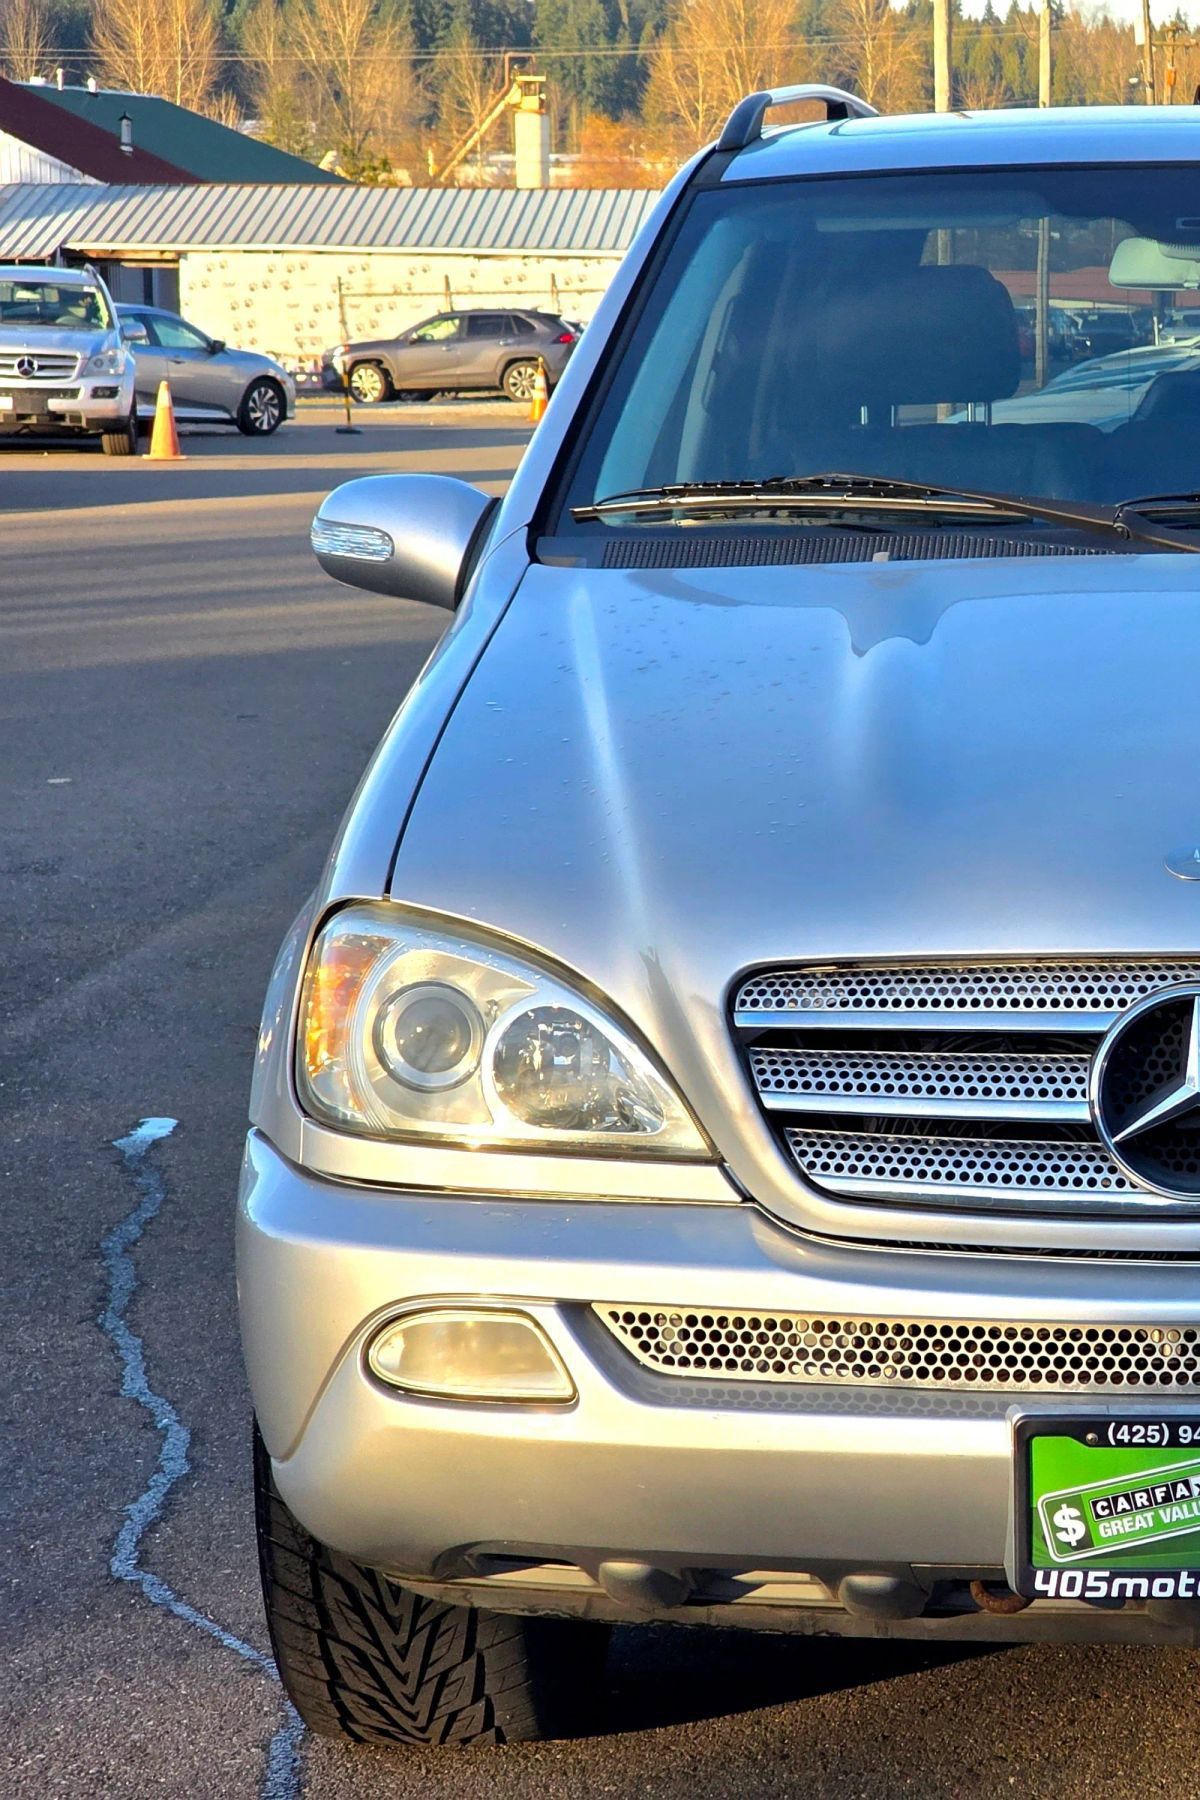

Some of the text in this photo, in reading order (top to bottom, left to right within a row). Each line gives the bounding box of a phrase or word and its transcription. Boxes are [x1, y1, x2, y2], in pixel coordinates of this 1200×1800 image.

[1107, 1422, 1170, 1446] (425)
[1053, 1503, 1086, 1546] $
[1099, 1512, 1155, 1538] GREAT
